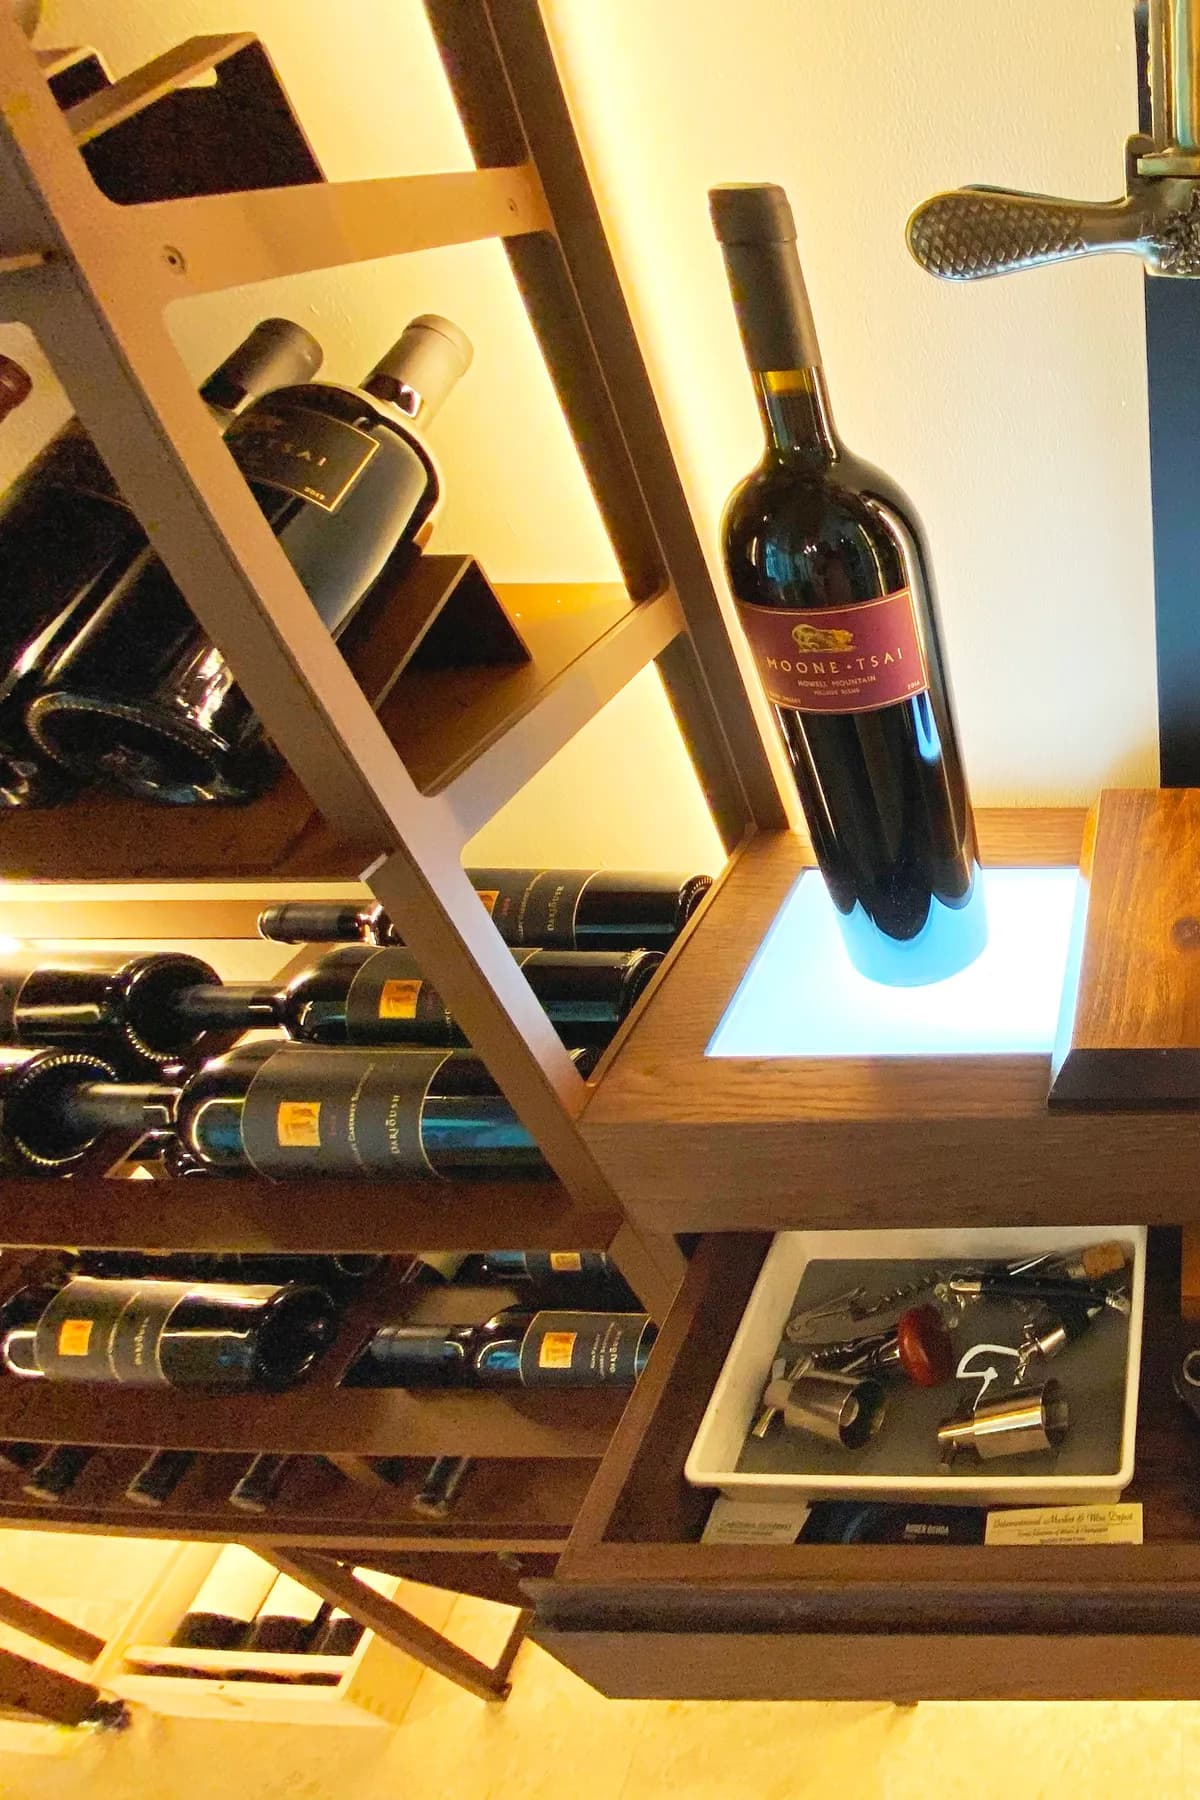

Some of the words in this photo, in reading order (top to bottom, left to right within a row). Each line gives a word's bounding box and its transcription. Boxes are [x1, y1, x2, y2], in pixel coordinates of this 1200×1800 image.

[766, 656, 840, 674] MOONE
[856, 647, 904, 671] TSAI
[797, 679, 827, 689] HOWELL
[831, 674, 877, 687] MOUNTAIN
